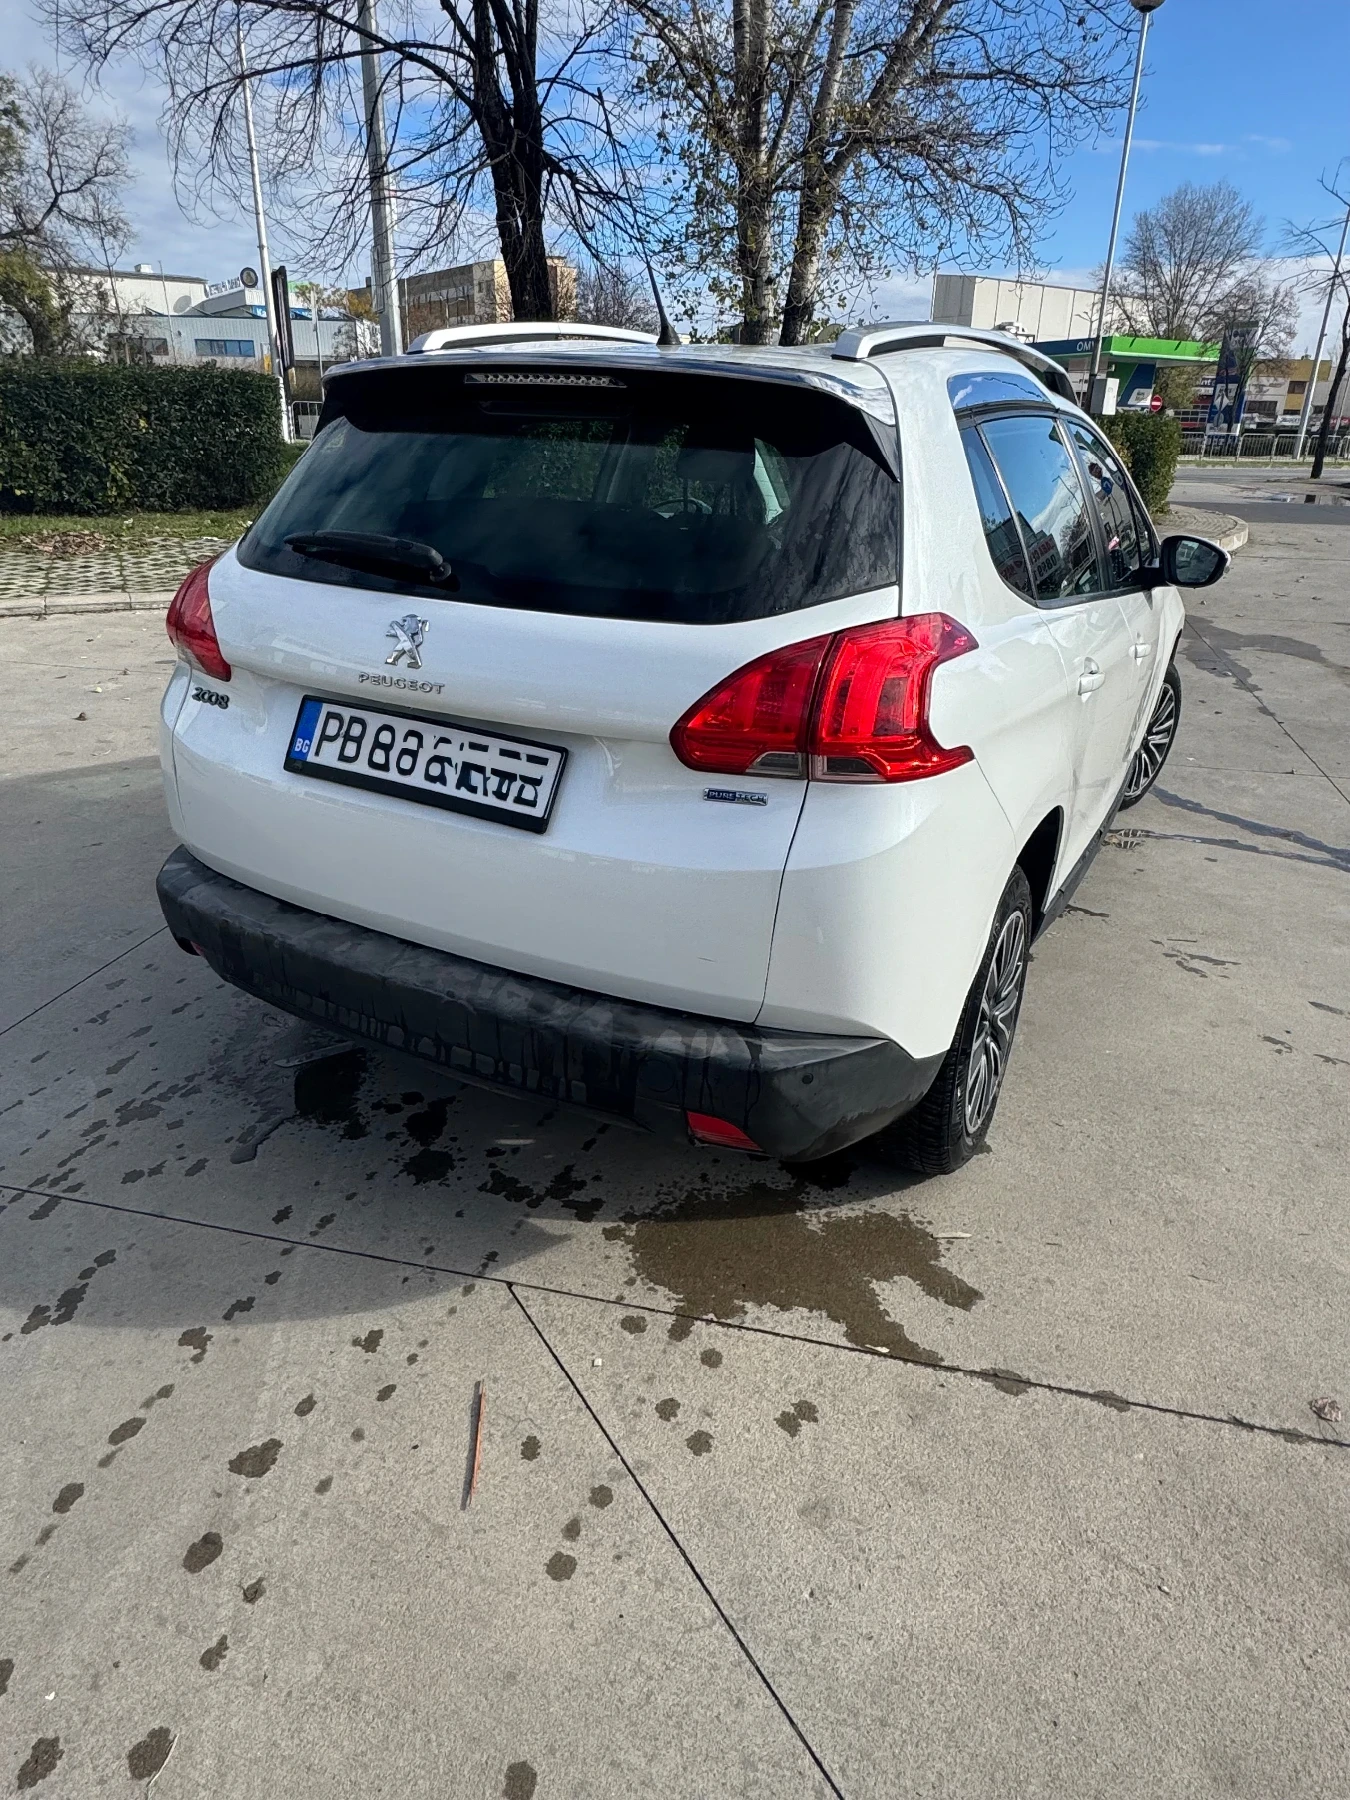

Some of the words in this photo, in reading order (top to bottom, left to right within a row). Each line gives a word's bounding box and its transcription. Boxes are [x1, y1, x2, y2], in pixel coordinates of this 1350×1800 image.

[358, 672, 446, 695] PEUGEOT
[192, 686, 230, 710] 2008
[294, 737, 311, 753] BG
